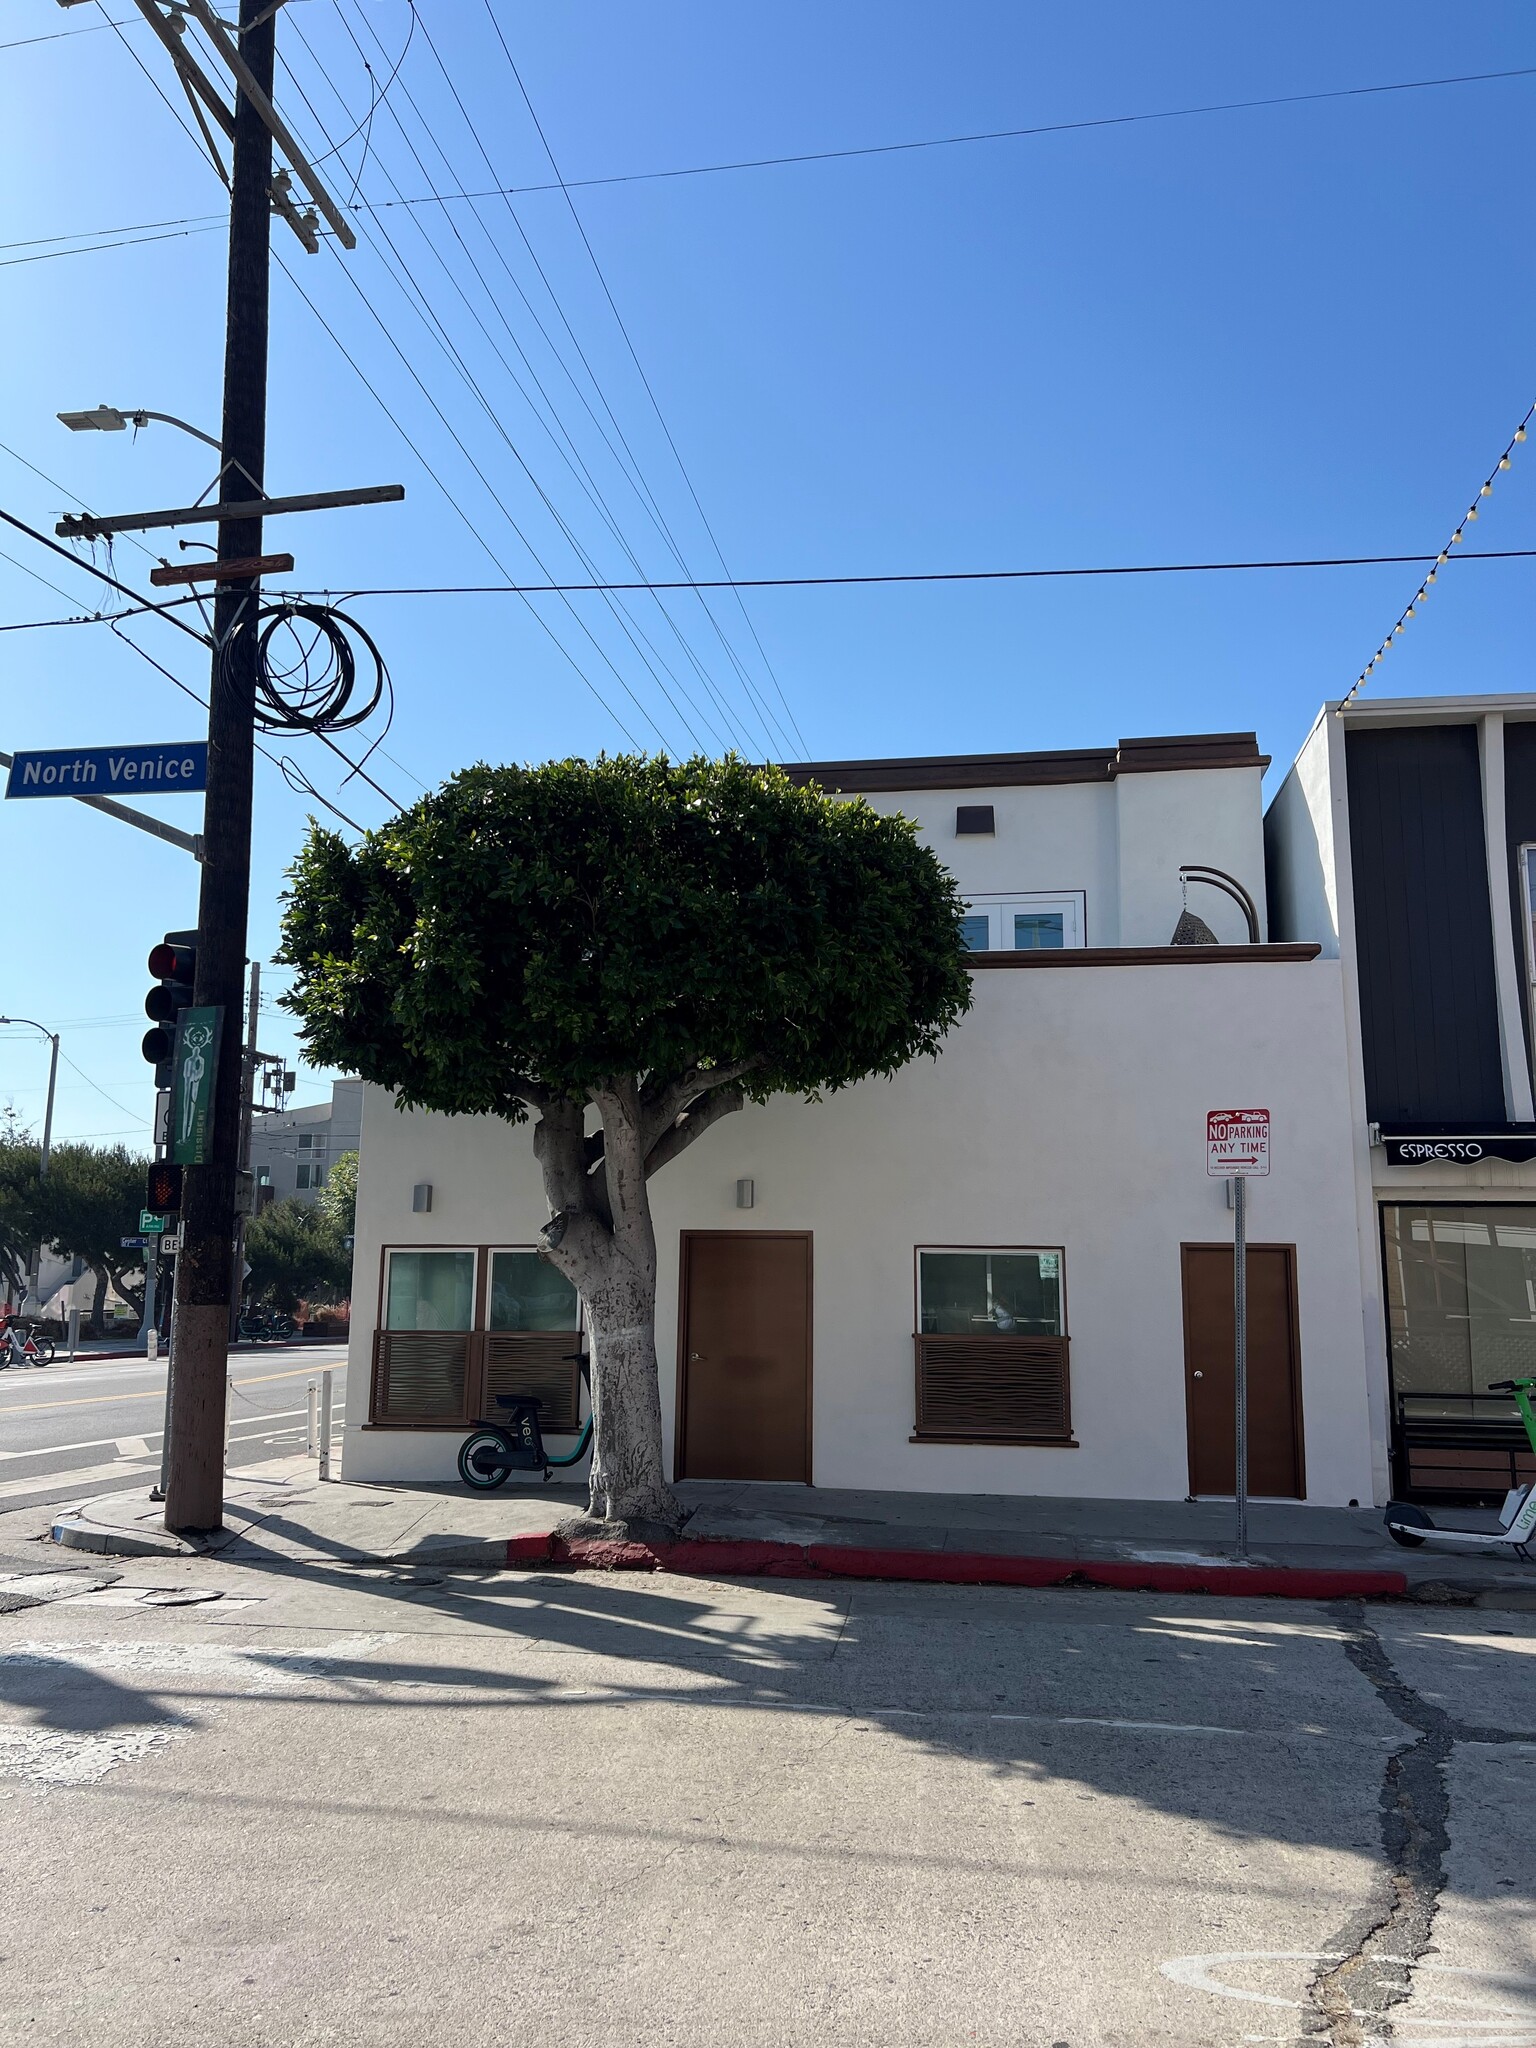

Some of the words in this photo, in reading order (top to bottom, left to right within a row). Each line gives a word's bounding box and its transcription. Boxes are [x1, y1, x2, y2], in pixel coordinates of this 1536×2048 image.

[22, 759, 98, 785] North
[108, 755, 195, 781] Venice
[1209, 1124, 1227, 1140] NO
[1229, 1125, 1268, 1139] PARKING
[1211, 1142, 1235, 1154] ANY
[1240, 1142, 1267, 1153] TIME
[1400, 1143, 1482, 1158] ESPRESSO
[164, 1239, 180, 1251] BE
